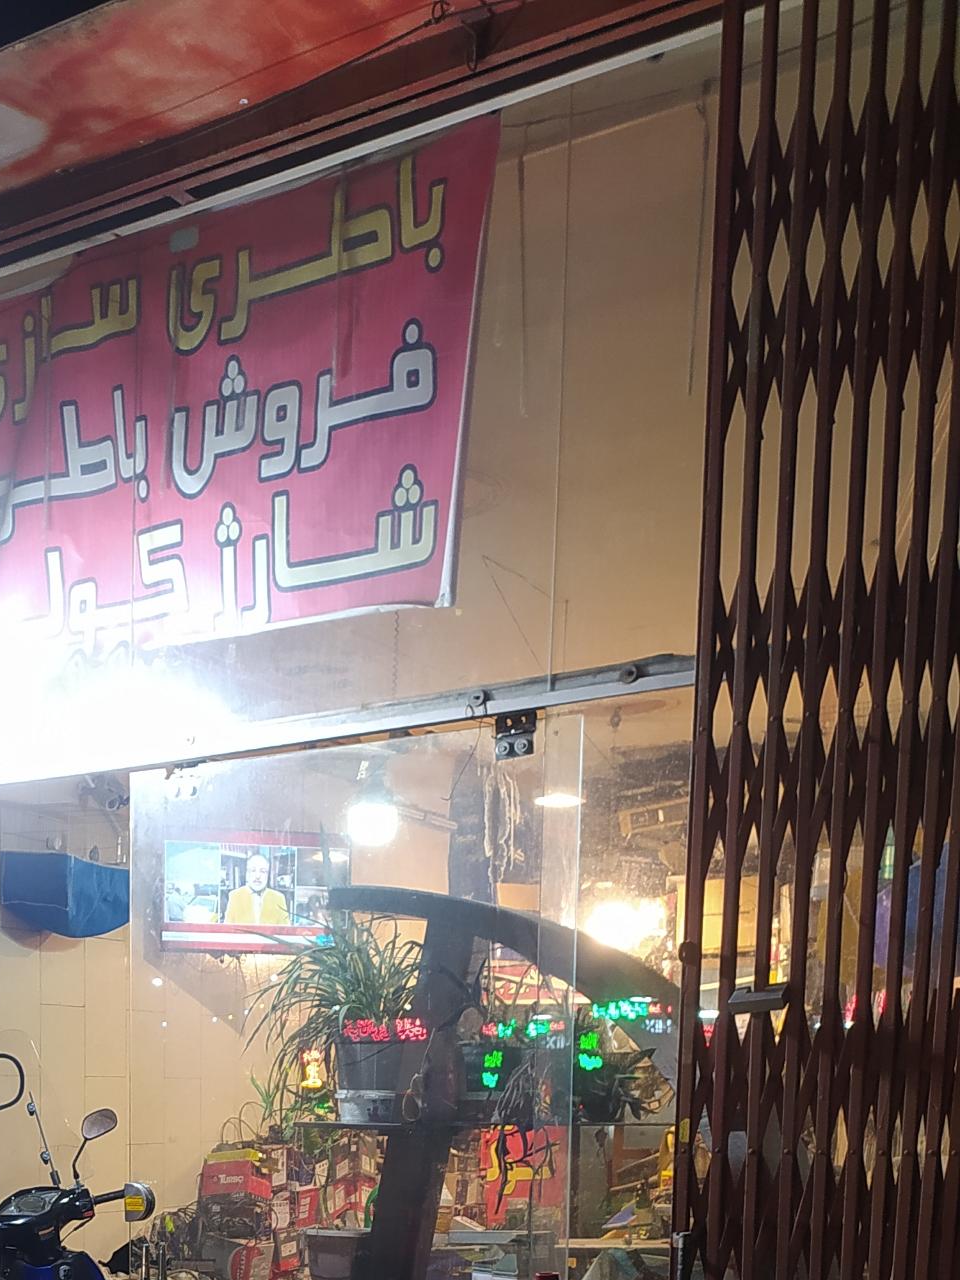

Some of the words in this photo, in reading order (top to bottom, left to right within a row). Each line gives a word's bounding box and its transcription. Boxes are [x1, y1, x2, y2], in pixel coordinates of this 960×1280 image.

[166, 154, 448, 355] باطری
[171, 318, 438, 499] فروش
[22, 518, 190, 646] کول
[212, 464, 438, 636] شارژ
